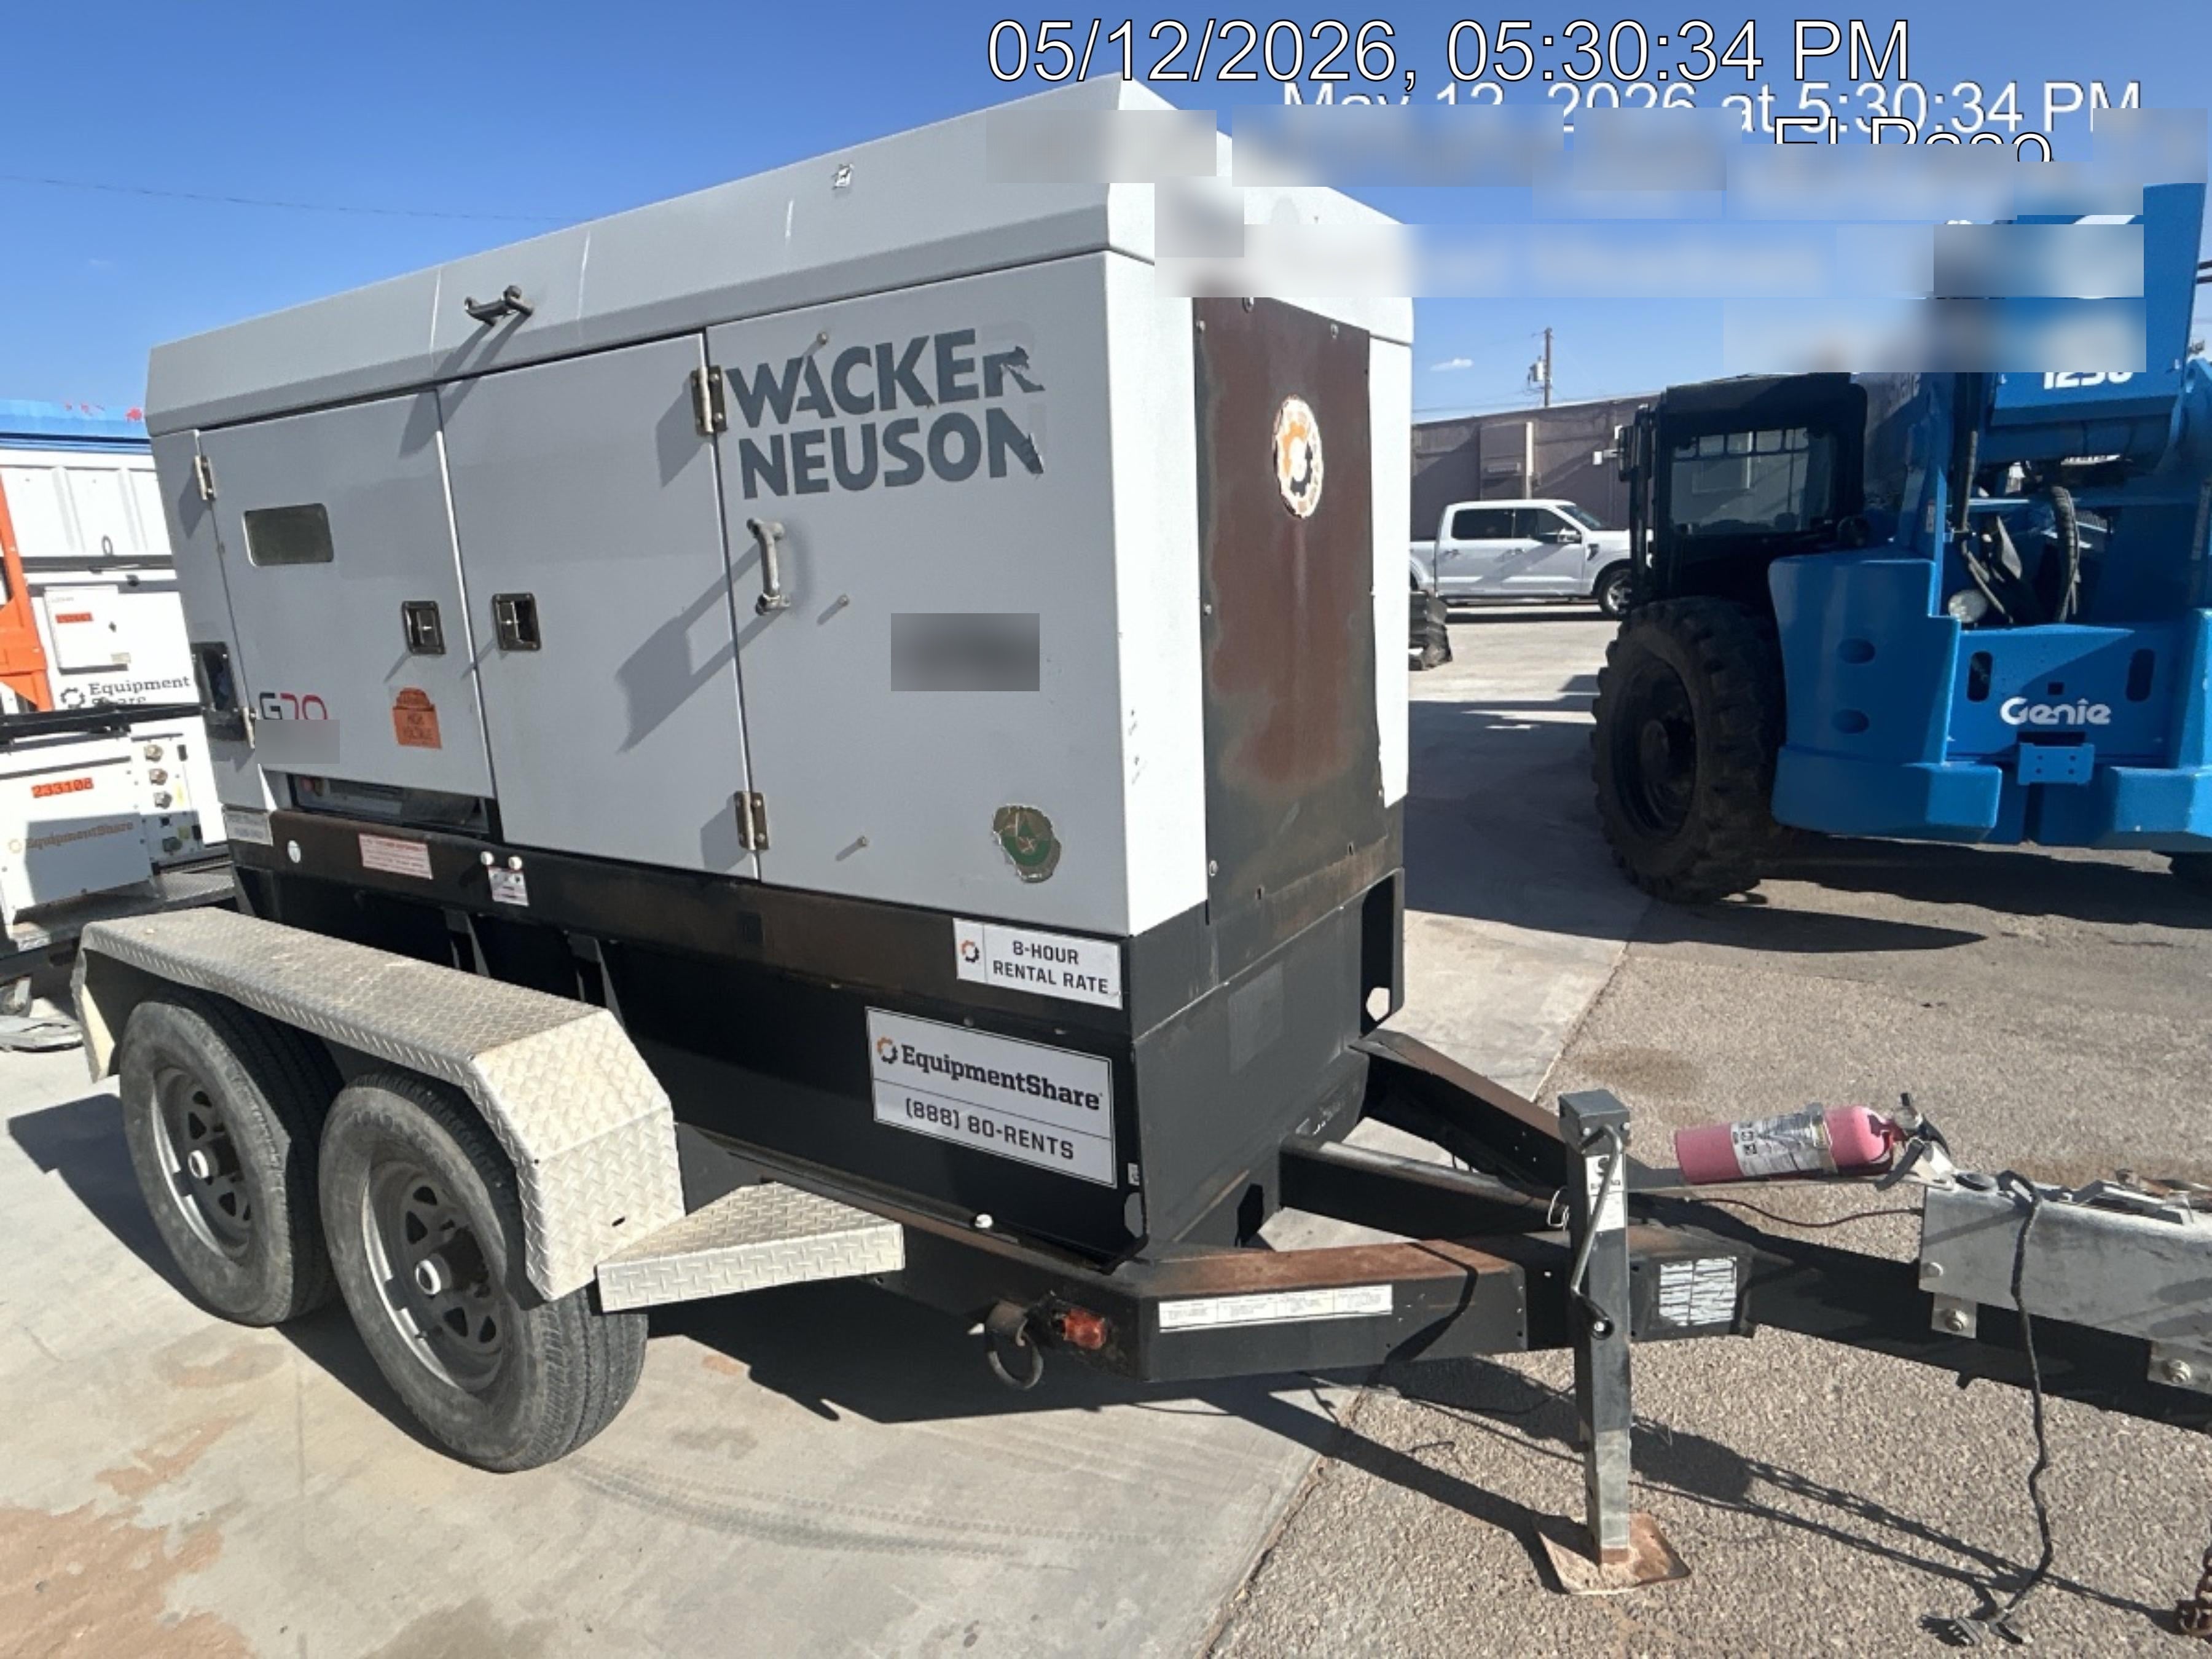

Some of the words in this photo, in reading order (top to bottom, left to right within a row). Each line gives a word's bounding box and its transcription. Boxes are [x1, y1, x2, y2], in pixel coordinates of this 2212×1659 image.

[726, 329, 1045, 428] WACKER
[739, 407, 1043, 500] NEUSON
[88, 676, 190, 696] Equipment
[1999, 697, 2111, 725] Genie
[1013, 940, 1079, 965] 8-HOUR
[993, 960, 1057, 985] RENTAL
[1063, 972, 1108, 994] RATE
[901, 1043, 1100, 1111] EquipmentShare
[906, 1097, 960, 1130] (888)
[967, 1115, 1074, 1160] 80-RENTS
